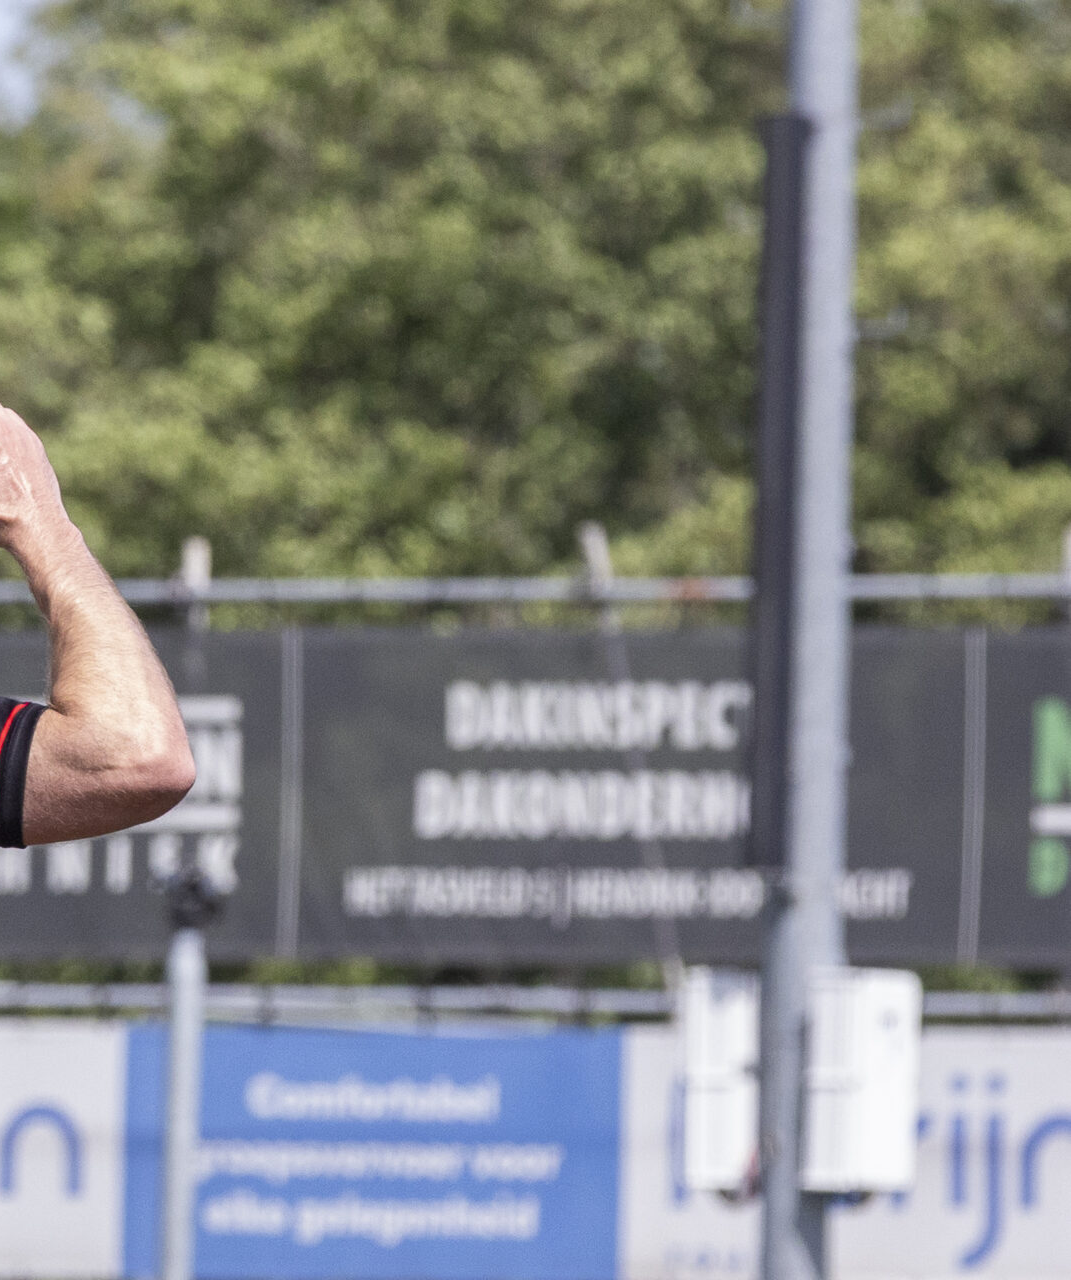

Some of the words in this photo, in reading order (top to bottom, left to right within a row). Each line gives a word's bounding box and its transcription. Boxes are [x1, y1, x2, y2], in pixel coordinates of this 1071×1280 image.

[416, 771, 750, 838] DAKONDERH
[248, 1074, 498, 1121] Comfortabel
[471, 1144, 561, 1182] voor
[204, 1190, 287, 1234] elke
[296, 1195, 536, 1244] gelegenheid
